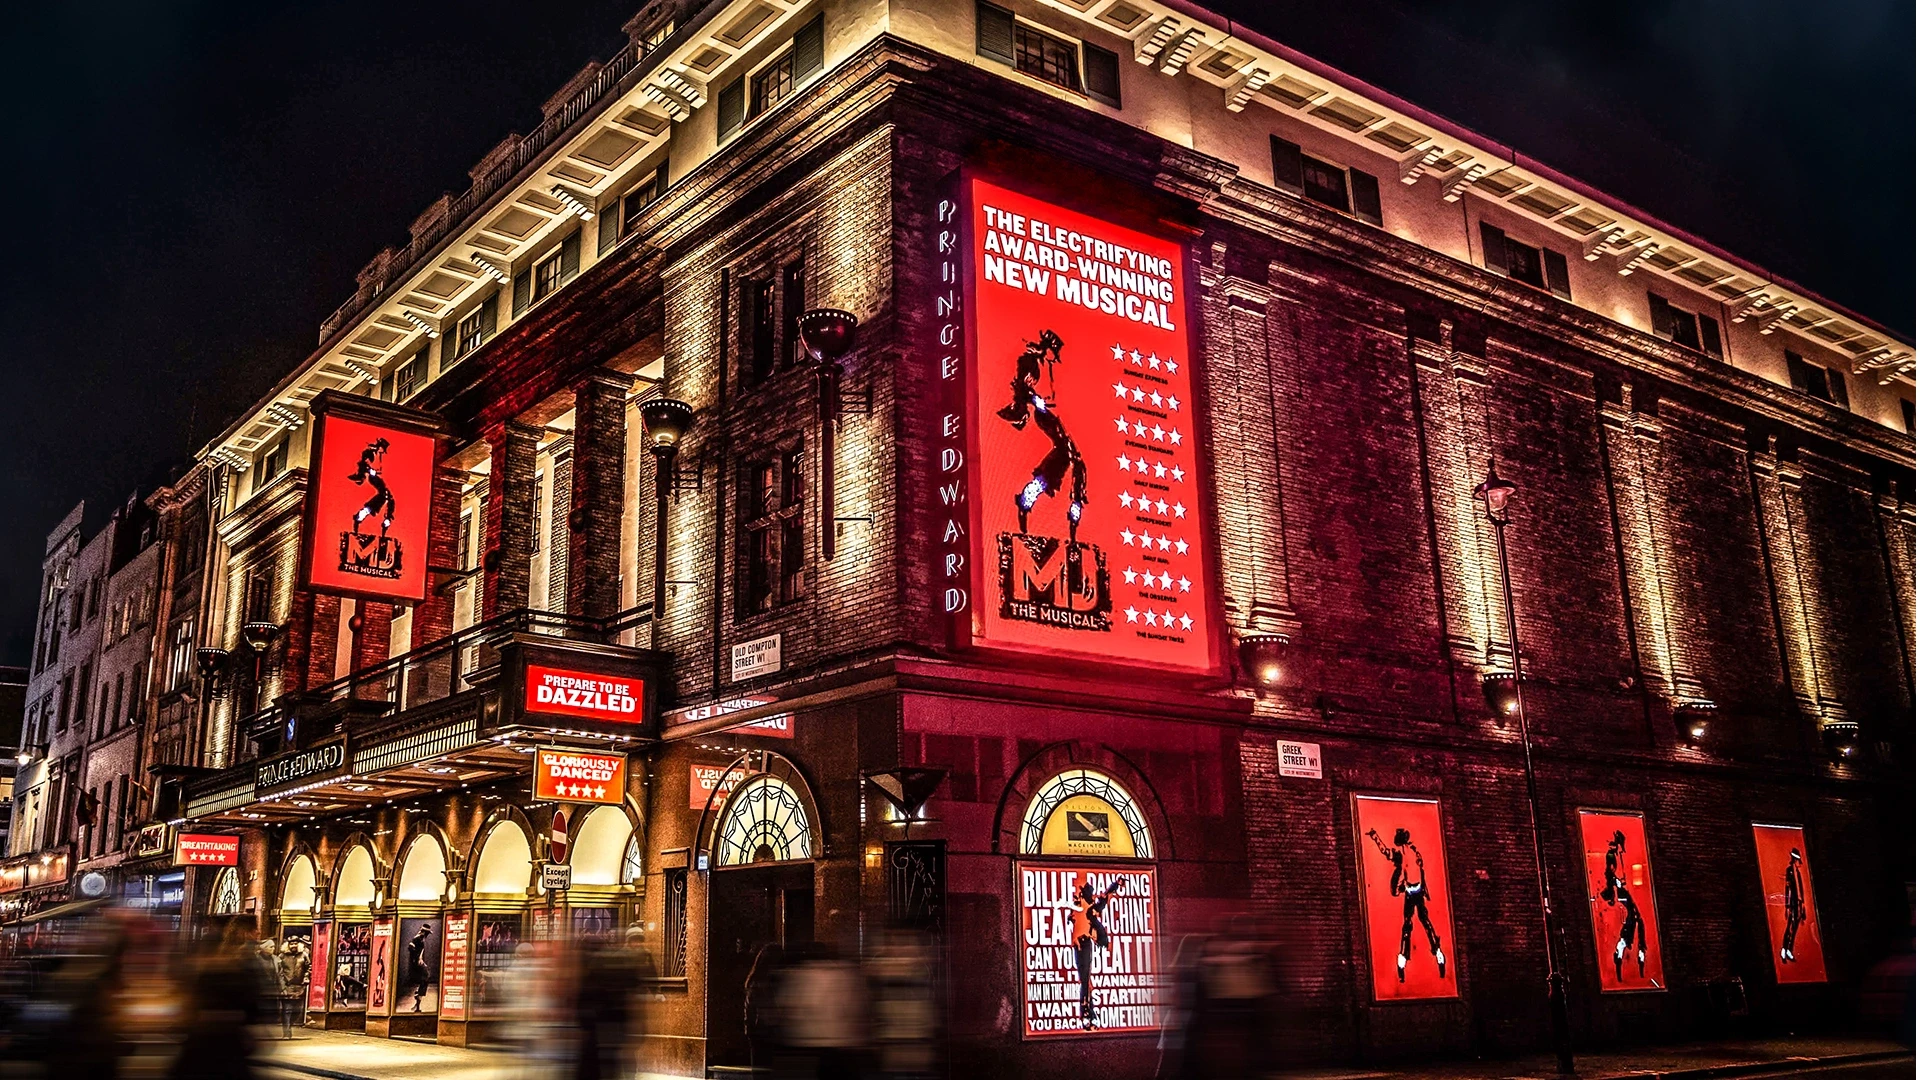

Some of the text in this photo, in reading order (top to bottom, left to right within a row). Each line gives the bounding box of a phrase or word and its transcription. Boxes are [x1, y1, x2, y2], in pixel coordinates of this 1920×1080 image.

[982, 204, 1172, 280] THE ELECTRIFYING
[984, 230, 1174, 304] AWARD-WINNING
[984, 254, 1176, 332] NEW MUSICAL
[937, 199, 965, 613] PRINCE EDWARD
[347, 533, 395, 569] MJ
[344, 564, 393, 578] THE MUSICAL
[1012, 536, 1098, 611] MJ
[1010, 602, 1098, 628] THE MUSICAL
[735, 639, 777, 658] OLD COMPTON
[735, 653, 766, 669] STREET W1
[598, 682, 613, 693] TO
[615, 684, 630, 695] BE
[1282, 744, 1302, 755] GREEK
[258, 745, 342, 787] PRINCE EDWARD
[1283, 755, 1318, 767] STREET W1
[546, 867, 568, 877] Except
[546, 877, 567, 886] cycles
[1023, 870, 1077, 907] BILLIE
[1099, 897, 1152, 934] ACHINE
[1026, 946, 1053, 970] CAN
[1091, 935, 1152, 973] BEAT IT
[1027, 970, 1079, 982] FEEL IT
[1090, 974, 1154, 988] WANNA BE
[1027, 983, 1042, 1001] MAN
[1043, 983, 1051, 1001] IN
[1051, 983, 1063, 1001] THE
[1028, 1001, 1081, 1018] I WANT
[1028, 1018, 1052, 1031] YOU
